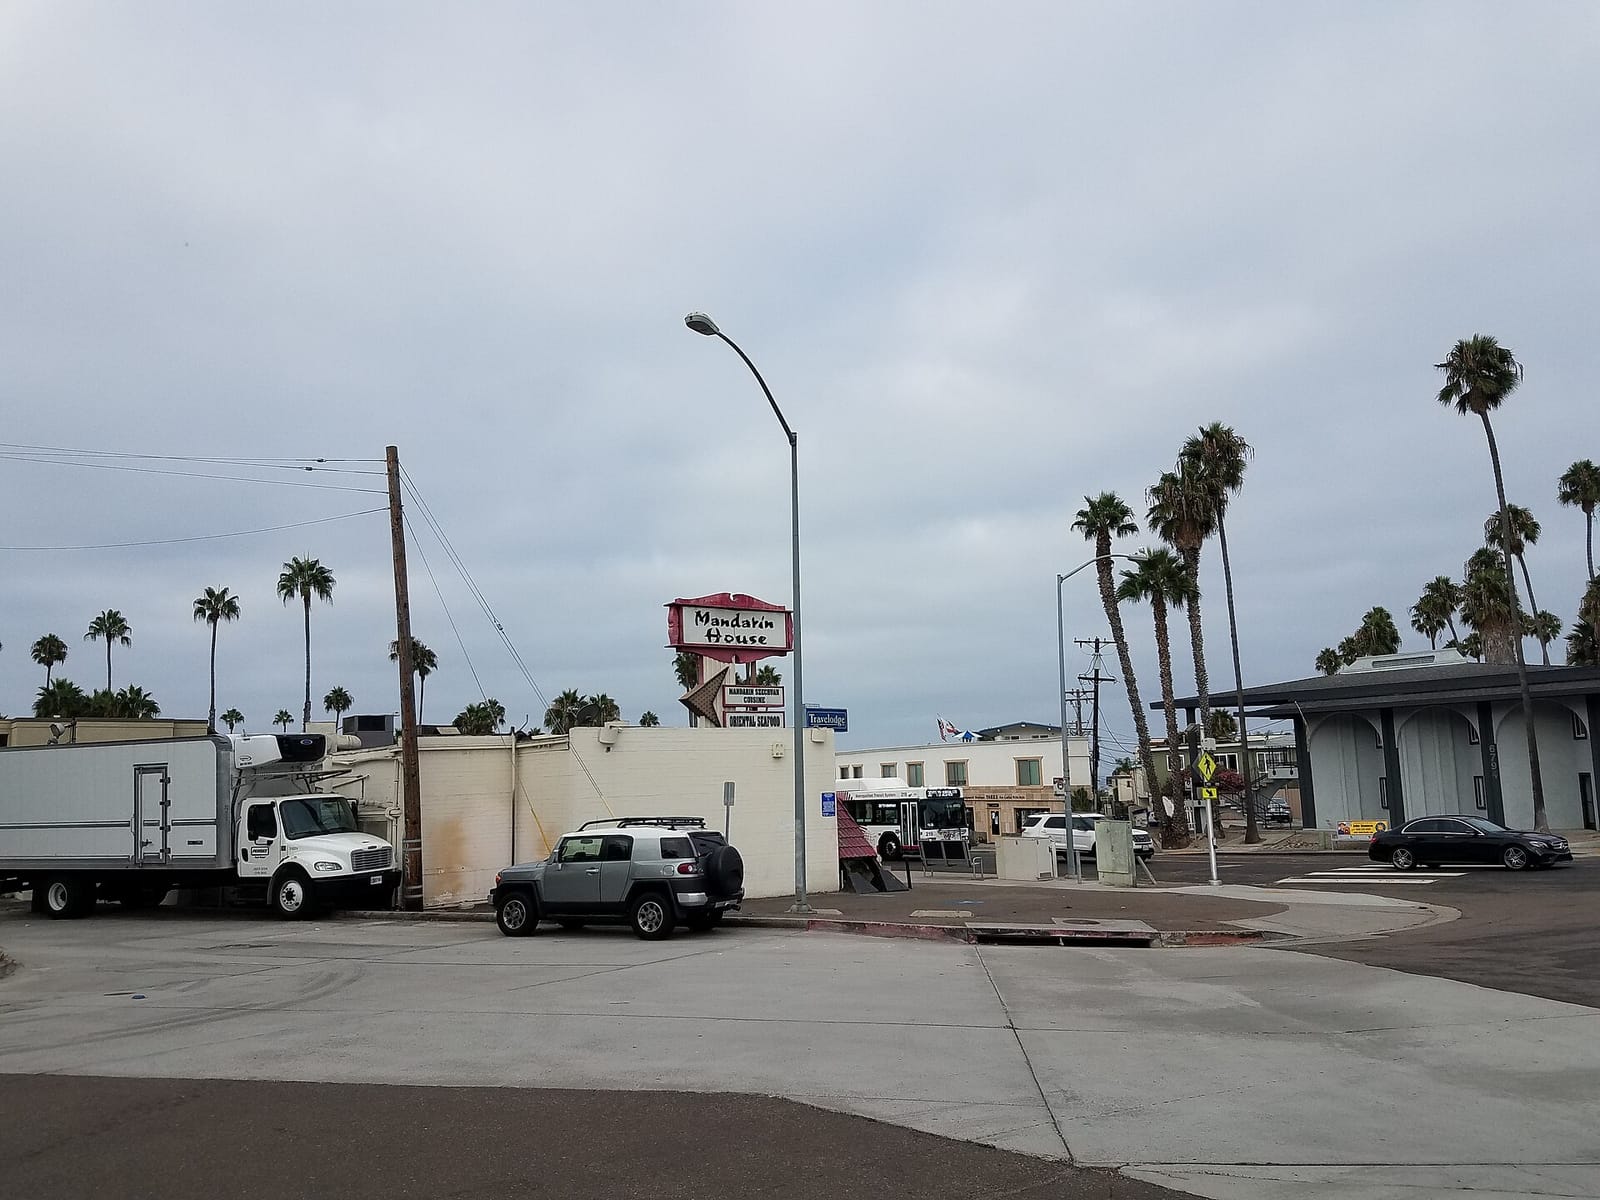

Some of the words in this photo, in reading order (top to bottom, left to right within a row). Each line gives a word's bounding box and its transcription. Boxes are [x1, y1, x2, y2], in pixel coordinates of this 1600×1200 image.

[695, 610, 774, 629] Mandarin
[704, 627, 767, 645] House
[728, 687, 754, 695] MANDARIN
[729, 715, 756, 727] ORIENTAL
[757, 715, 780, 727] SEAFOOD
[808, 713, 846, 726] Travelodge
